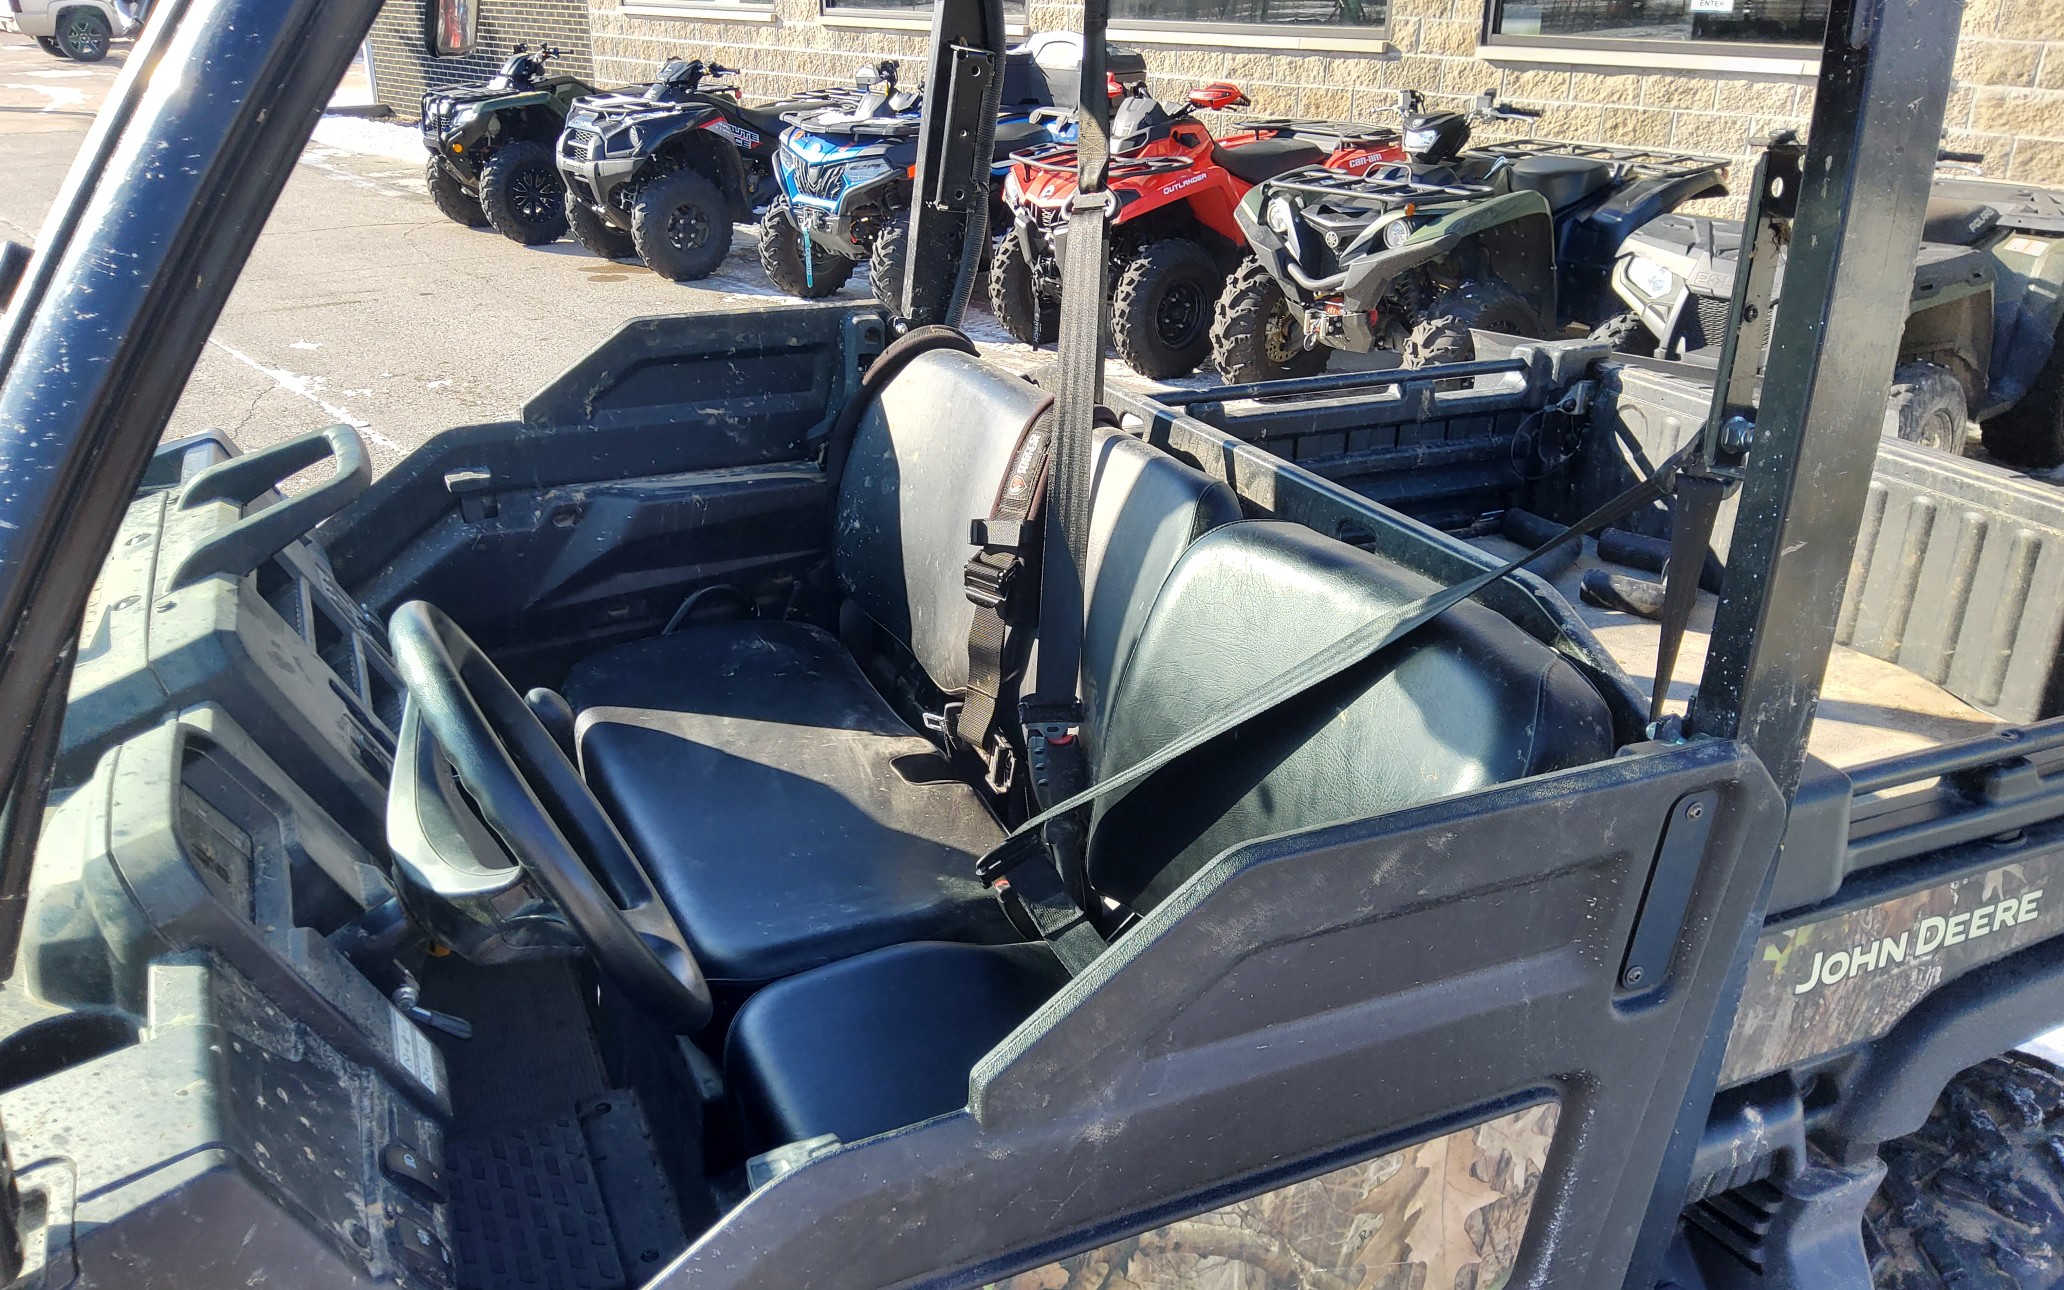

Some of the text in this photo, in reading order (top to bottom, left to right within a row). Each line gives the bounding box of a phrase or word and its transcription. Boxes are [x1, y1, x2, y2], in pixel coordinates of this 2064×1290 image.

[1163, 173, 1207, 195] OUTLANDER
[1794, 889, 2044, 995] JOHN DEERE
